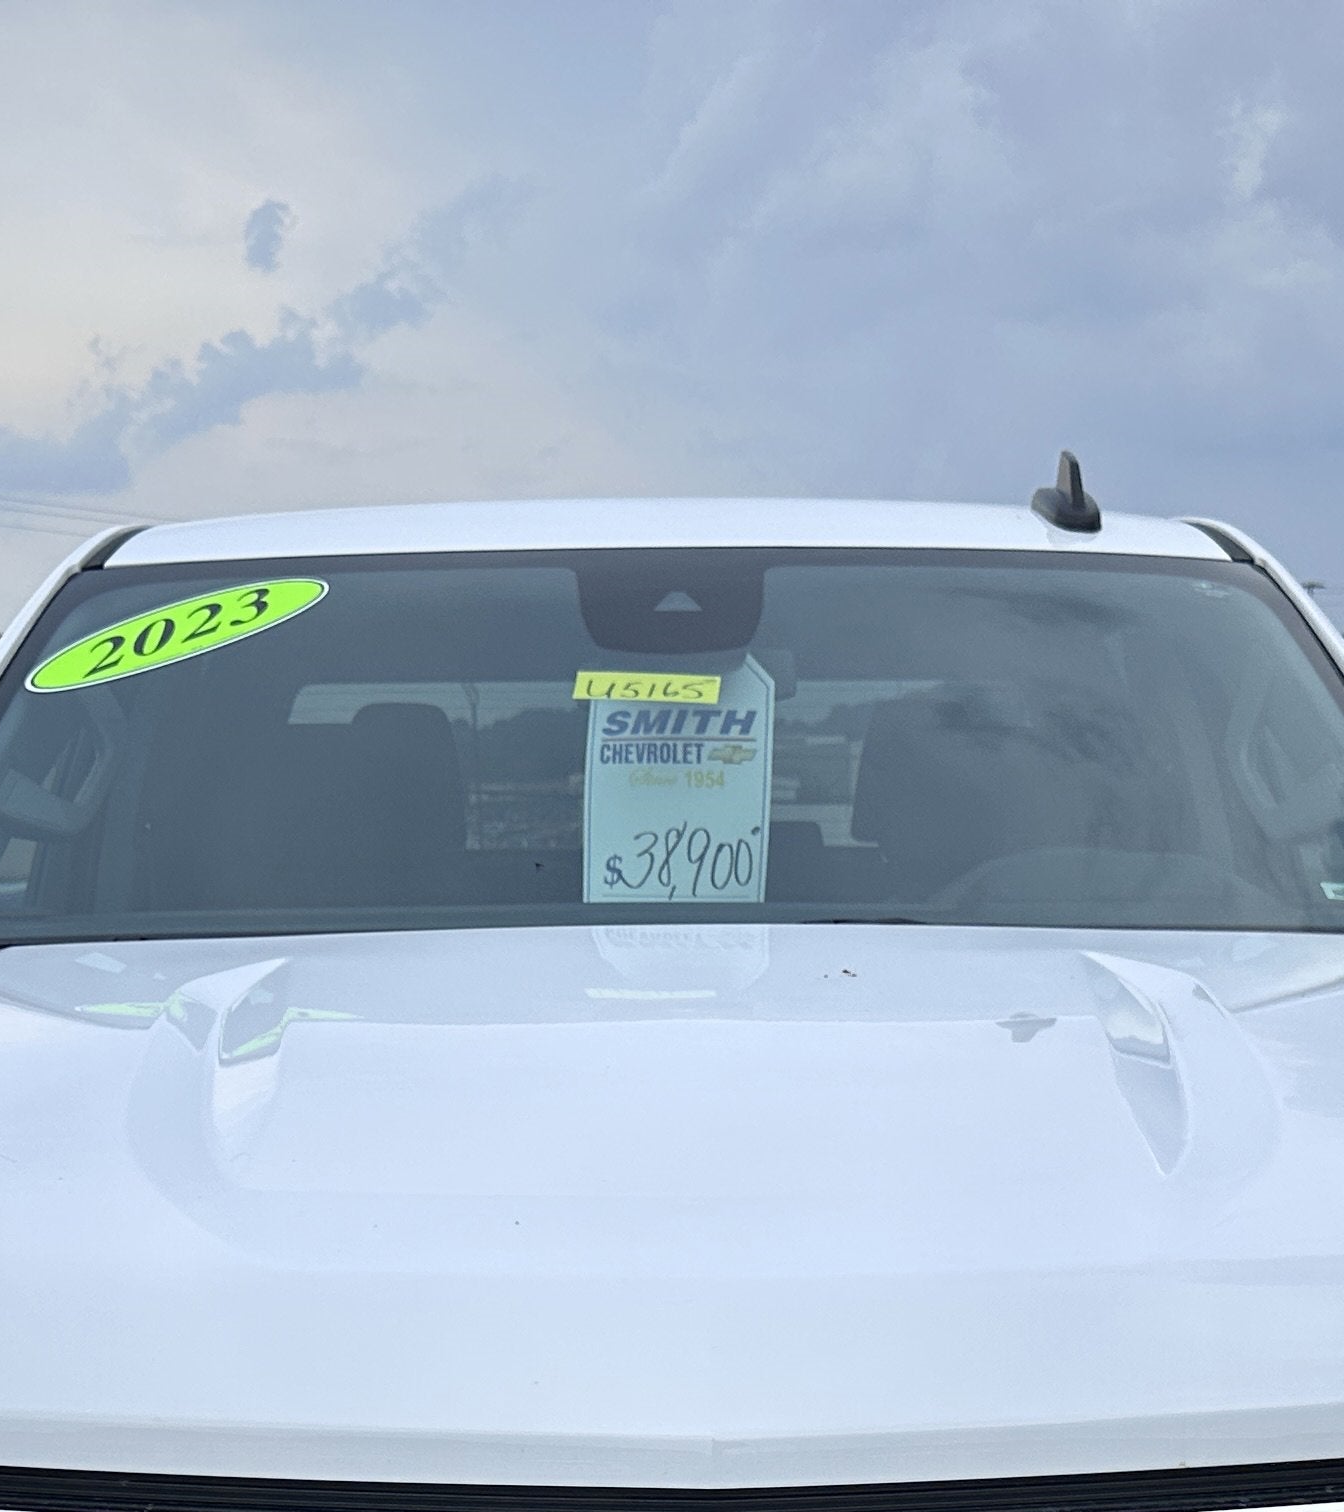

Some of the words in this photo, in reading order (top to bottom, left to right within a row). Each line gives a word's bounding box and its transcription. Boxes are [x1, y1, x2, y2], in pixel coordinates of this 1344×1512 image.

[82, 588, 270, 679] 2023
[586, 679, 718, 700] U5165
[602, 709, 758, 736] SMITH
[600, 743, 705, 765] CHEVROLET
[685, 769, 725, 788] 1954
